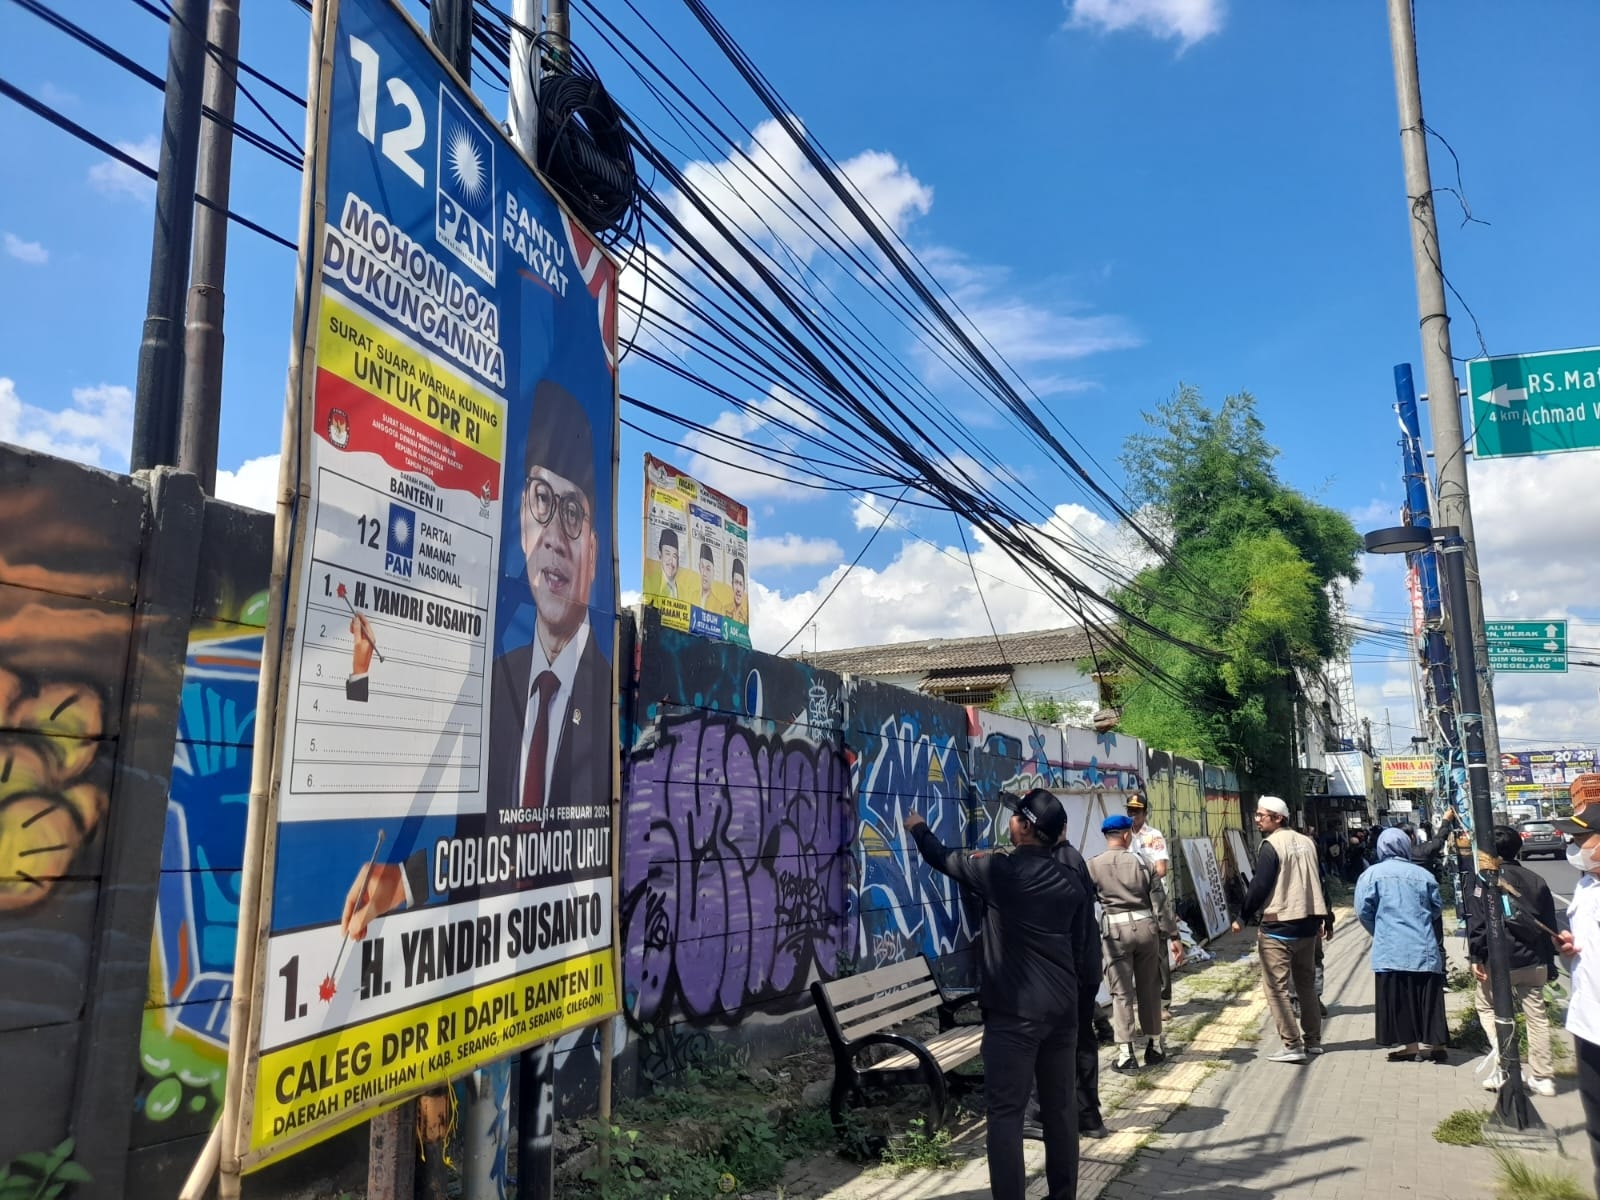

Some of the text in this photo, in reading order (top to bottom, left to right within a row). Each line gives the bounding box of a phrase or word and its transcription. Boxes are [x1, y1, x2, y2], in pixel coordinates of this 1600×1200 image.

[350, 34, 425, 188] 12
[439, 194, 494, 273] PAN
[507, 191, 564, 266] BANTU
[345, 199, 497, 338] MOHON DO'A
[503, 218, 568, 297] RAKYAT
[324, 236, 504, 382] DUKUNGANNYA
[330, 316, 498, 428] SURAT SUARA WARNA KUNING
[354, 351, 480, 444] UNTUK DPR RI
[1489, 409, 1520, 422] 4 km
[1522, 402, 1586, 426] Achmad
[390, 477, 444, 514] BANTEN II
[357, 513, 381, 550] 12
[420, 521, 452, 546] PARTAI
[385, 551, 413, 579] PAN
[418, 542, 457, 567] AMANAT
[417, 562, 463, 589] NASIONAL
[324, 573, 482, 637] 1. H. YANDRI SUSANTO
[319, 624, 328, 639] 2.
[316, 663, 324, 678] 3.
[313, 699, 321, 713] 4.
[310, 738, 318, 752] 5.
[1385, 761, 1416, 770] AMIRA
[545, 805, 555, 821] 14
[557, 806, 593, 820] FEBRUARI
[594, 804, 610, 819] 2024
[435, 826, 611, 893] COBLOS NOMOR URUT
[279, 954, 308, 1022] 1.
[360, 937, 391, 1001] H.
[401, 913, 502, 989] YANDRI
[506, 892, 602, 959] SUSANTO
[275, 963, 603, 1106] CALEG DPR RI DAPIL BANTEN II
[273, 1096, 339, 1137] DAERAH
[344, 1062, 417, 1109] PEMILIHAN
[428, 1052, 454, 1073] KAB.
[457, 1034, 500, 1061] SERANG,
[502, 1019, 527, 1042] KOTA
[528, 1004, 565, 1032] SERANG,
[566, 991, 604, 1016] CILEGON)
